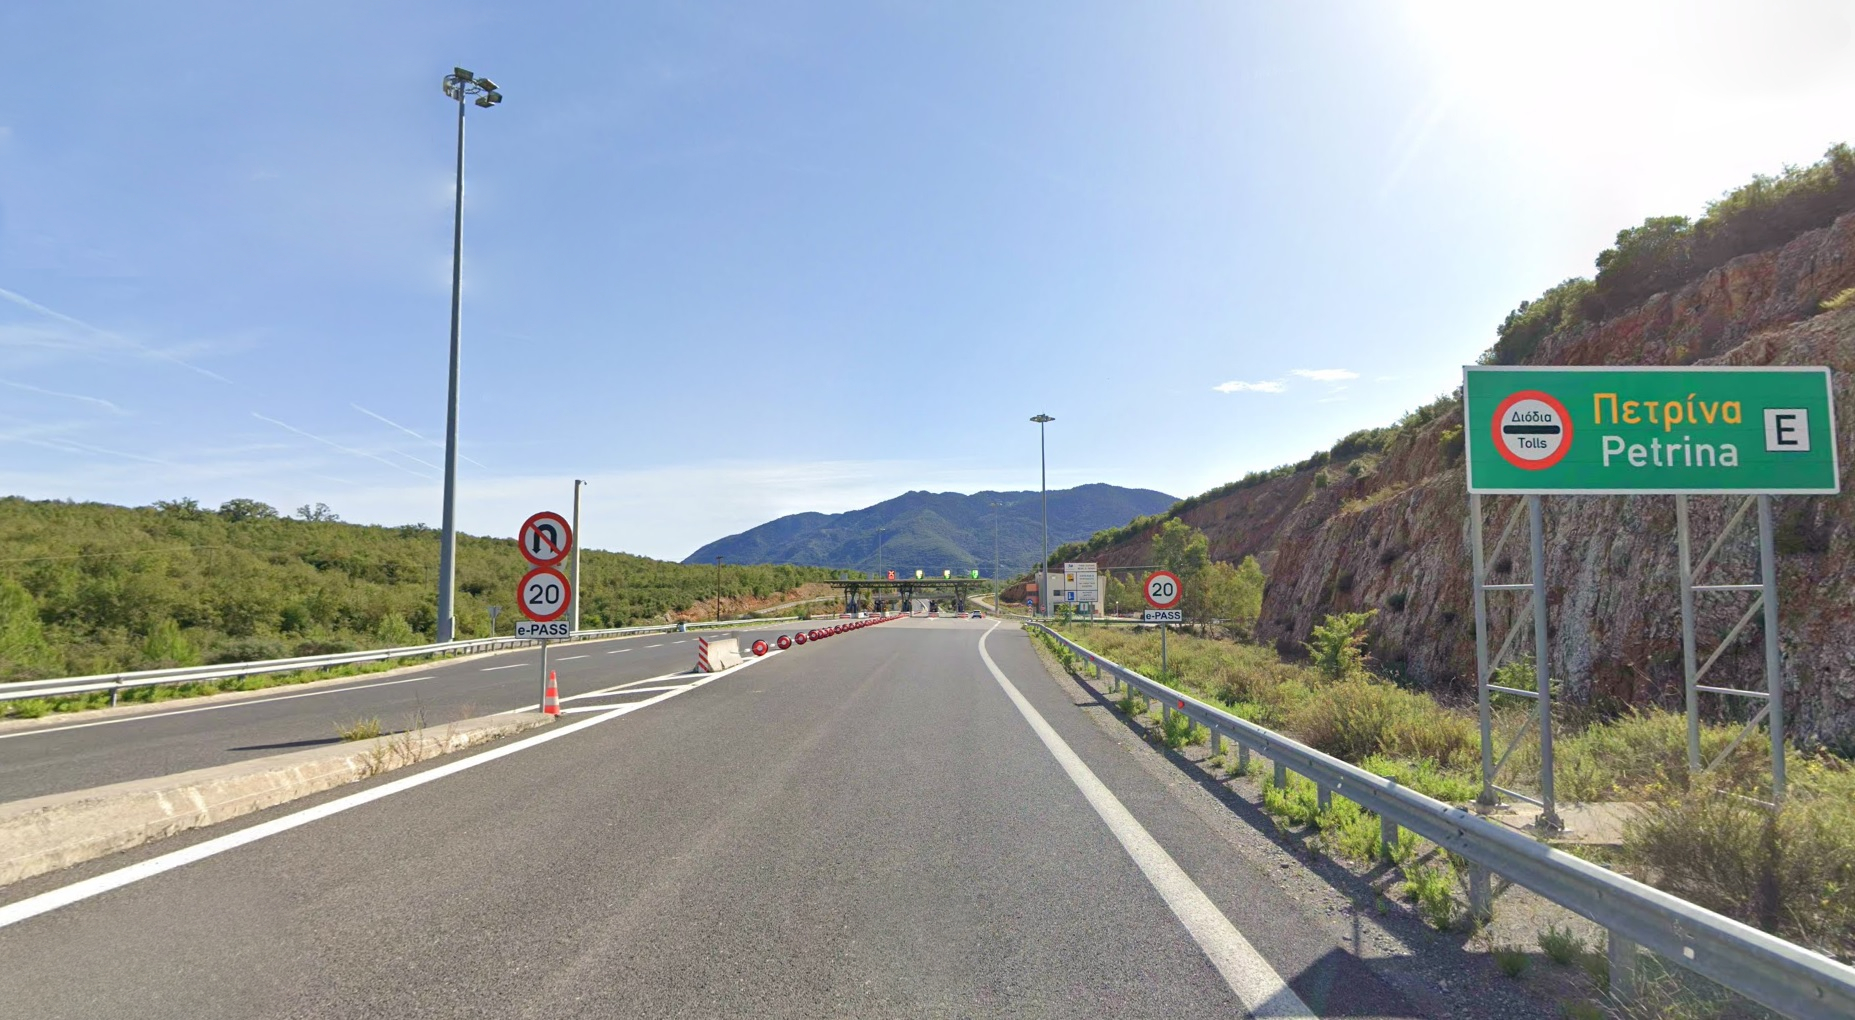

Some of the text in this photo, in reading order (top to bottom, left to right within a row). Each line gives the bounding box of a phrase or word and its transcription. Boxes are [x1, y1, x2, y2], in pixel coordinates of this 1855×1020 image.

[1511, 411, 1552, 422] Διόδια
[1593, 393, 1742, 432] Πετρίνα
[1518, 437, 1547, 449] Tolls
[1602, 435, 1738, 467] Petrina
[529, 584, 559, 604] 20
[1152, 583, 1173, 596] 20
[1146, 611, 1180, 620] e-PASS
[518, 624, 567, 635] e-PASS
